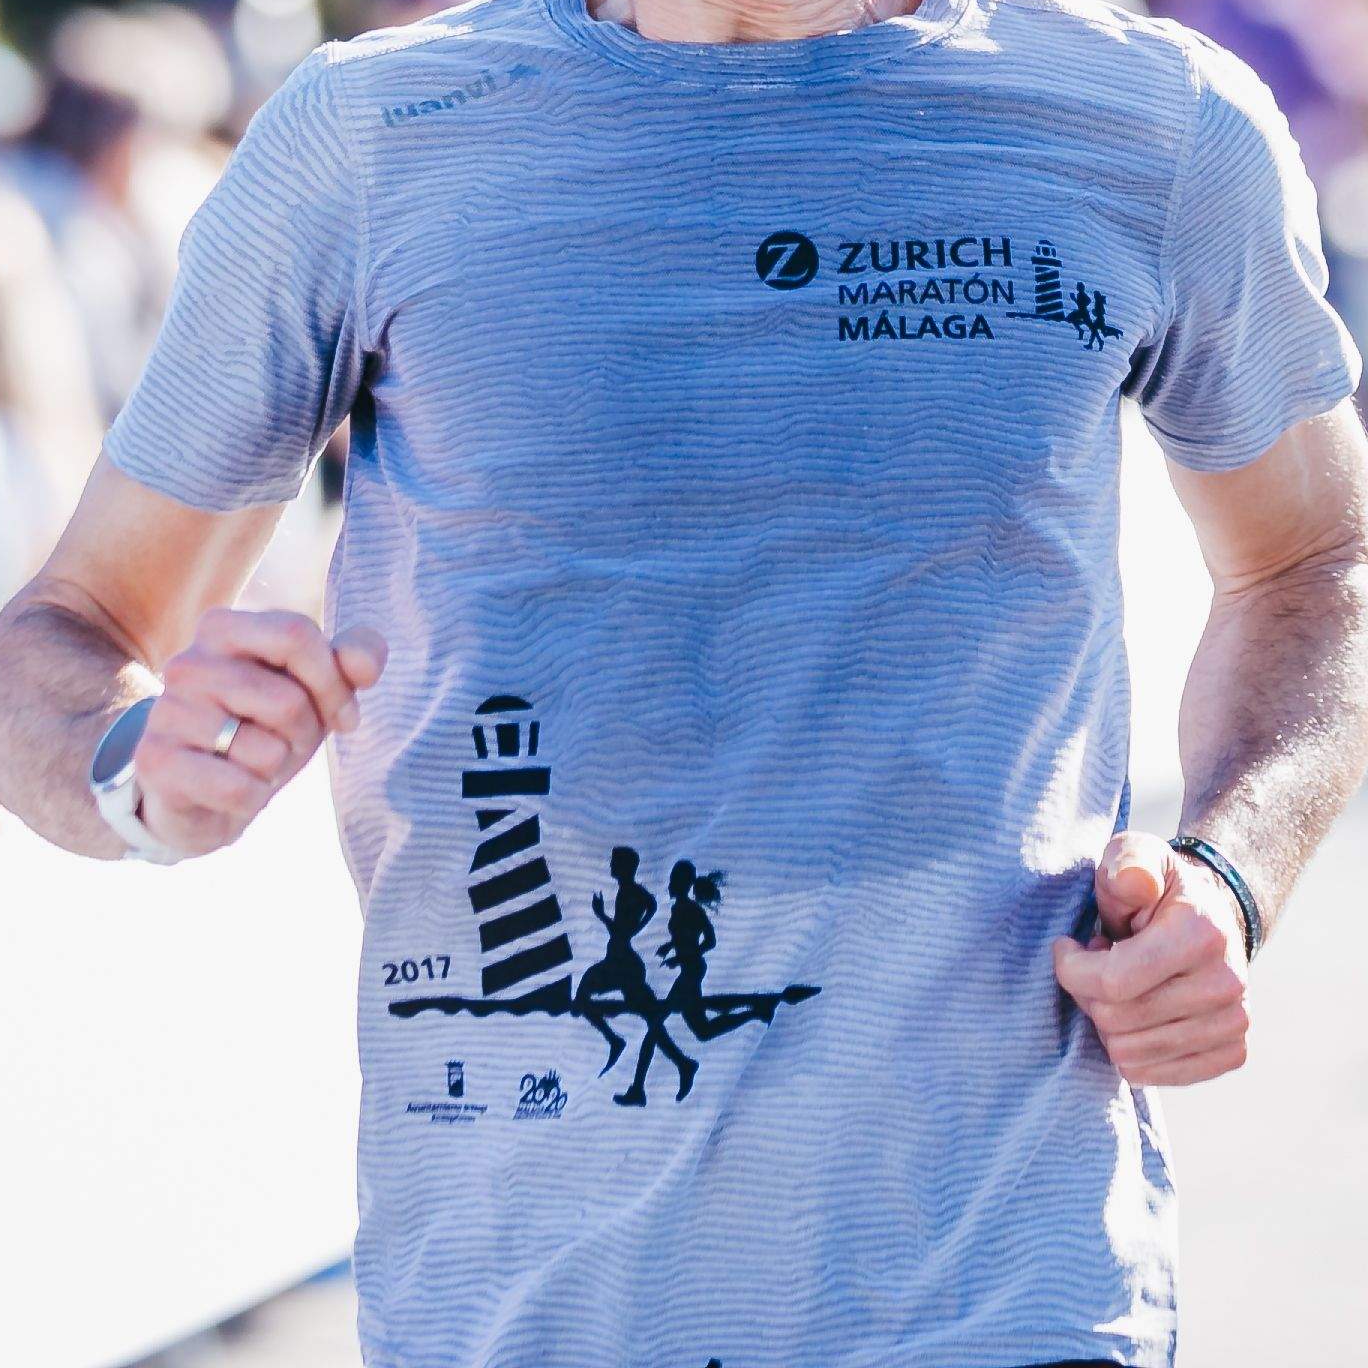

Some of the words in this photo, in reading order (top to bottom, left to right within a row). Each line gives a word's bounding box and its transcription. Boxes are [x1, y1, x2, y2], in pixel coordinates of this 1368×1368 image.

[838, 237, 1013, 272] ZURICH
[838, 273, 1016, 306] MARATÓN
[838, 310, 995, 342] MÁLAGA
[382, 955, 451, 985] 2017
